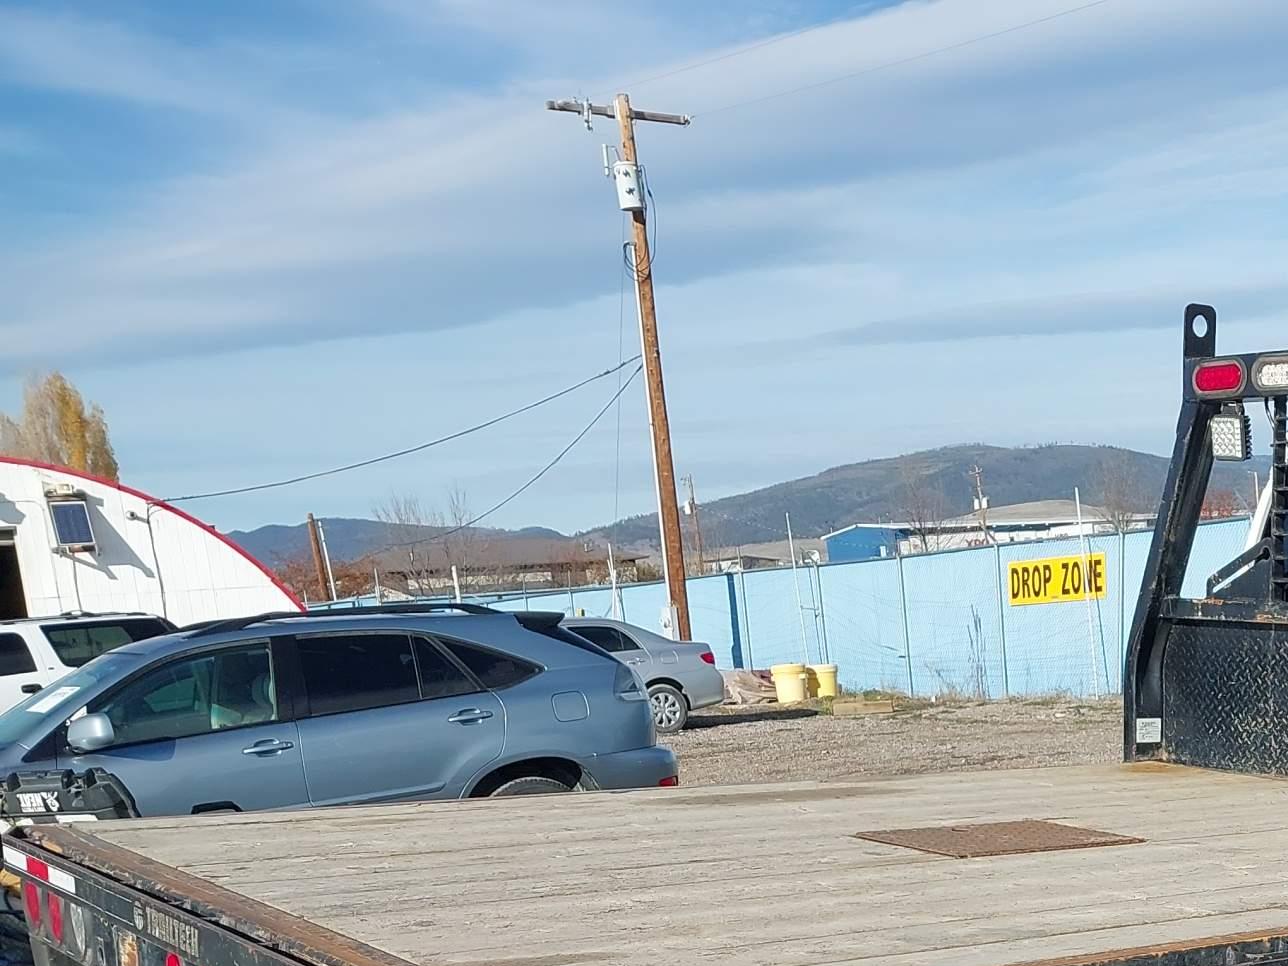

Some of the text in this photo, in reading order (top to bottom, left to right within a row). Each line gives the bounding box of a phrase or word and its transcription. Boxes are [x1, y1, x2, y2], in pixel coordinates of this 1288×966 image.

[1010, 559, 1103, 599] DROP ZONE
[145, 905, 199, 958] TRAILTECH
